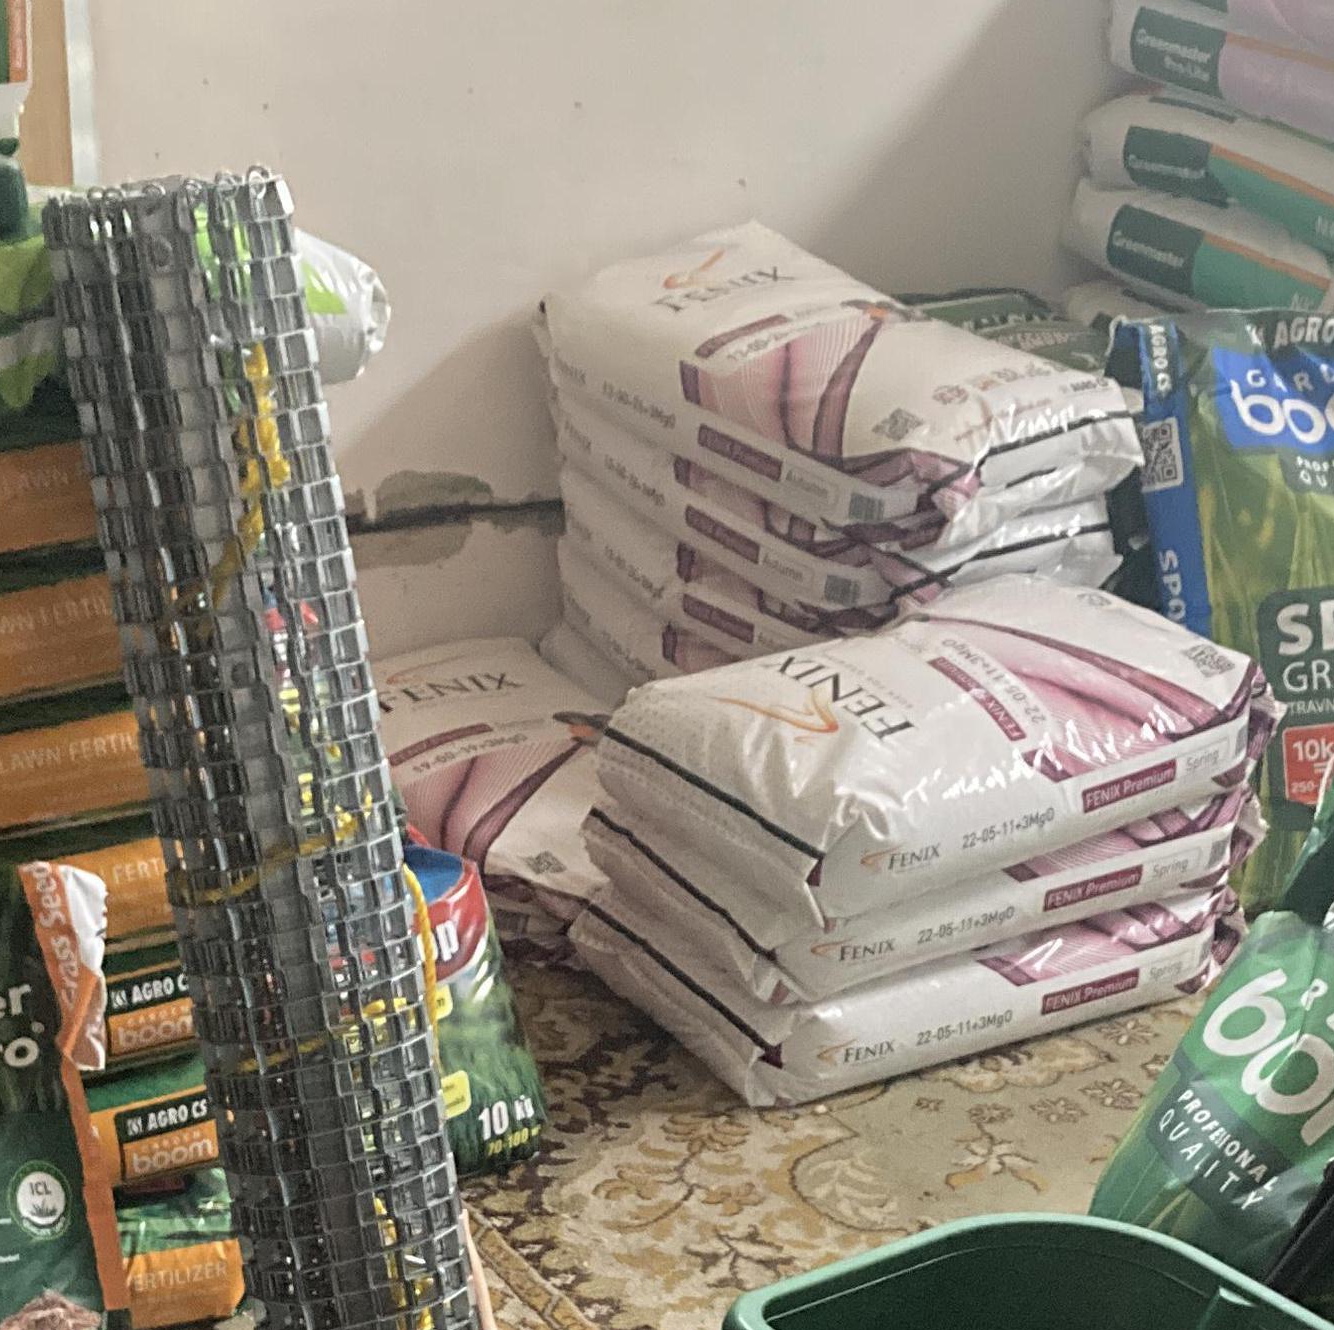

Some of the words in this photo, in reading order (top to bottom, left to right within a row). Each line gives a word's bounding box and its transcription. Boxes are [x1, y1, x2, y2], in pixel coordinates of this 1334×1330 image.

[378, 672, 525, 714] FENIX
[763, 655, 917, 741] FENIX
[1084, 779, 1123, 811] FENIX
[1122, 764, 1177, 798] Premium
[1185, 749, 1221, 777] Spring
[961, 806, 1057, 850] 22-05-11+3MgO
[887, 842, 942, 871] FENIX
[34, 860, 55, 930] Seed
[1046, 886, 1085, 910] FENIX
[1085, 871, 1141, 902] Premium
[1152, 856, 1189, 882] Spring
[839, 937, 896, 962] FENIX
[130, 977, 175, 1003] AGRO
[177, 972, 191, 995] C
[1082, 974, 1140, 1001] Premium
[1148, 958, 1184, 985] Spring
[916, 1009, 1014, 1047] 22-05-11+3MgO
[842, 1039, 896, 1065] FENIX
[145, 1103, 191, 1132] AGRO
[192, 1097, 208, 1121] CS
[479, 1100, 509, 1142] 10
[132, 1135, 214, 1174] boom
[29, 1181, 52, 1197] ICL
